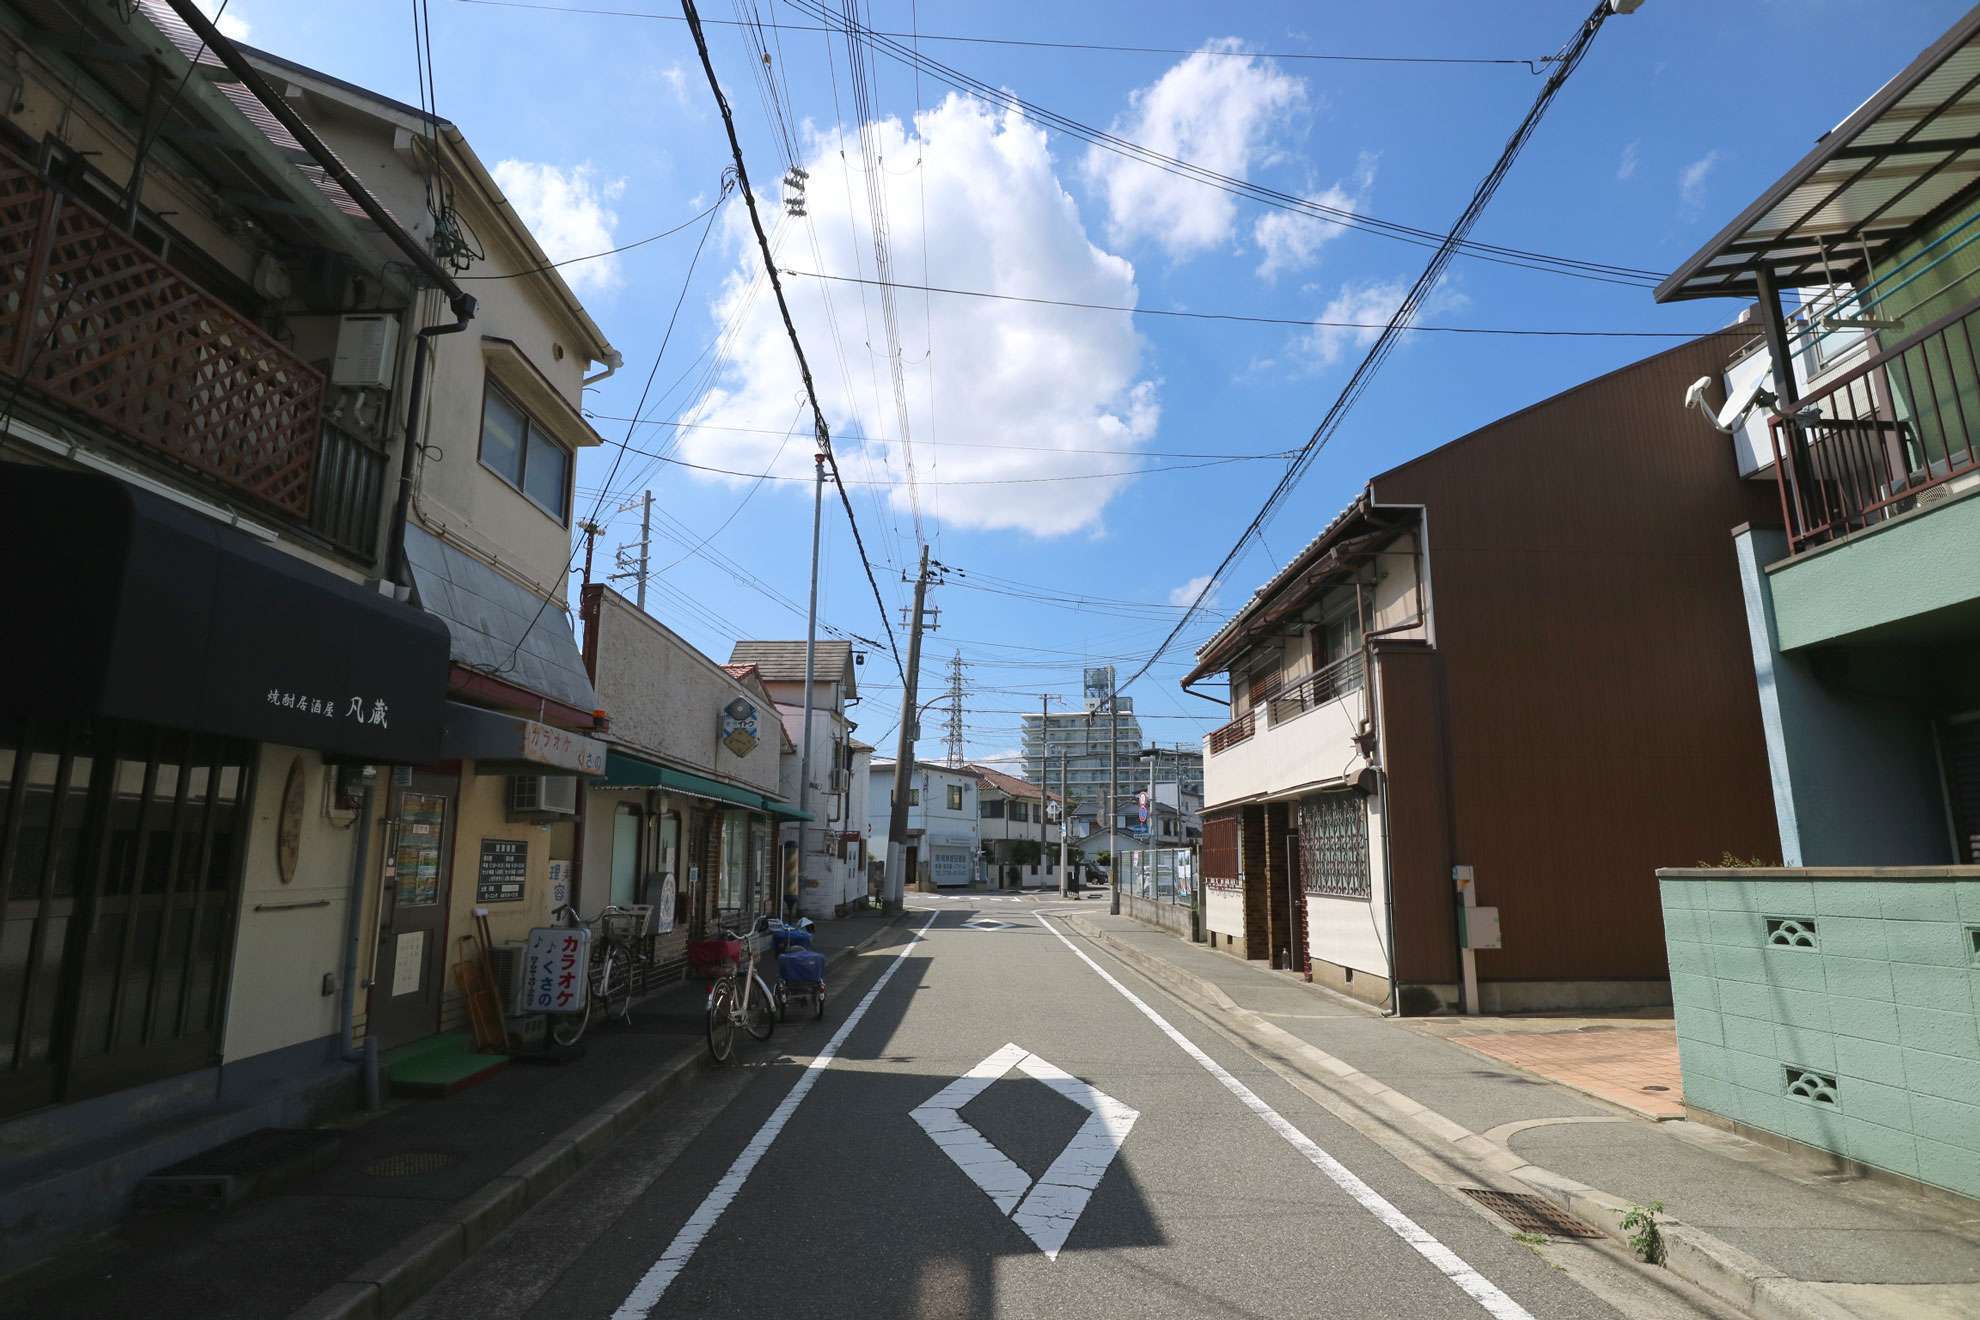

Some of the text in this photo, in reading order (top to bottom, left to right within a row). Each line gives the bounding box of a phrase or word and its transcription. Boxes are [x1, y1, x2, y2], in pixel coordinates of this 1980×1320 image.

[266, 688, 389, 729] 焼酎居酒屋 凡蔵
[538, 961, 553, 1007] くさの
[556, 936, 578, 1007] カラオケ
